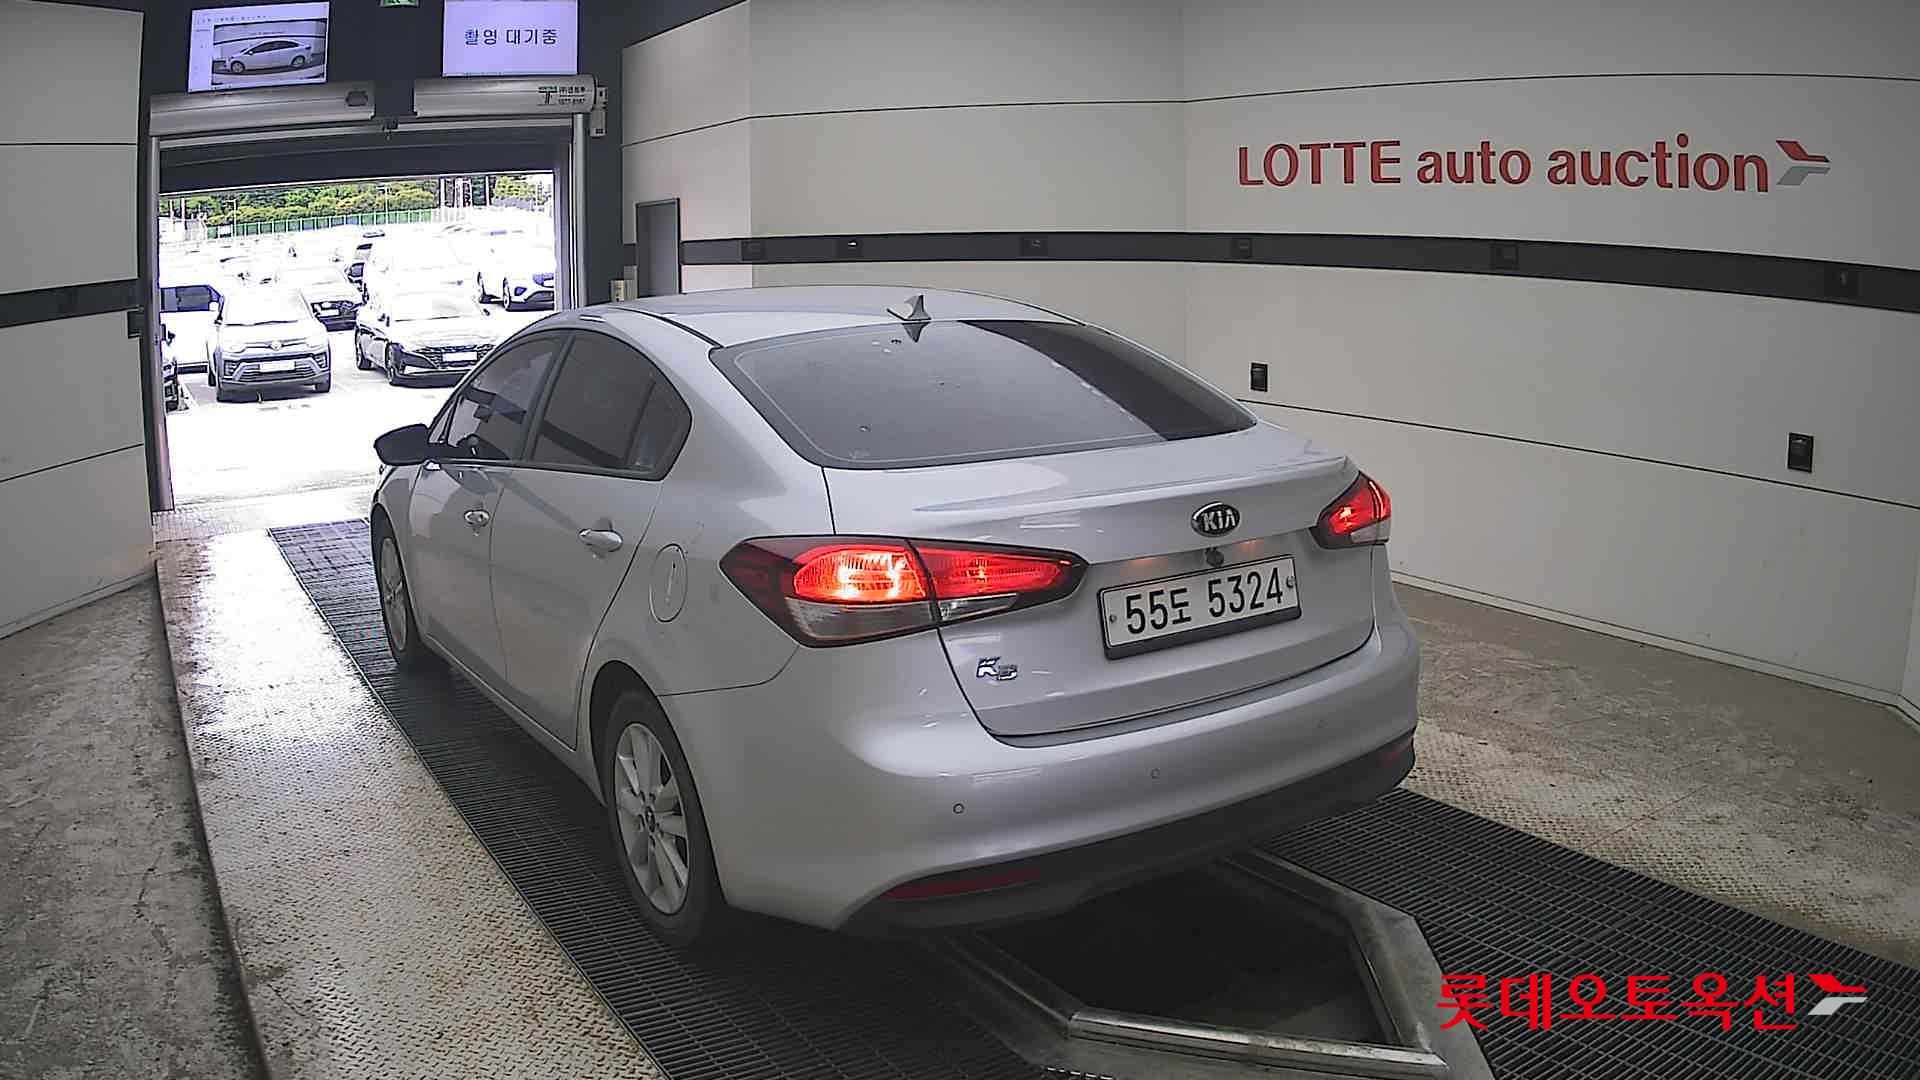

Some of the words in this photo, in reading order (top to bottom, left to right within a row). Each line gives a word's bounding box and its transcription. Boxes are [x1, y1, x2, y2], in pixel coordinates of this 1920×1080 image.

[464, 28, 498, 46] 촬영
[505, 28, 558, 46] 대기중
[1238, 139, 1402, 187] LOTTE
[1416, 140, 1532, 185] auto
[1547, 132, 1769, 193] auction
[1202, 508, 1239, 532] KIA
[1125, 586, 1192, 635] 55도
[1207, 567, 1284, 618] 5324
